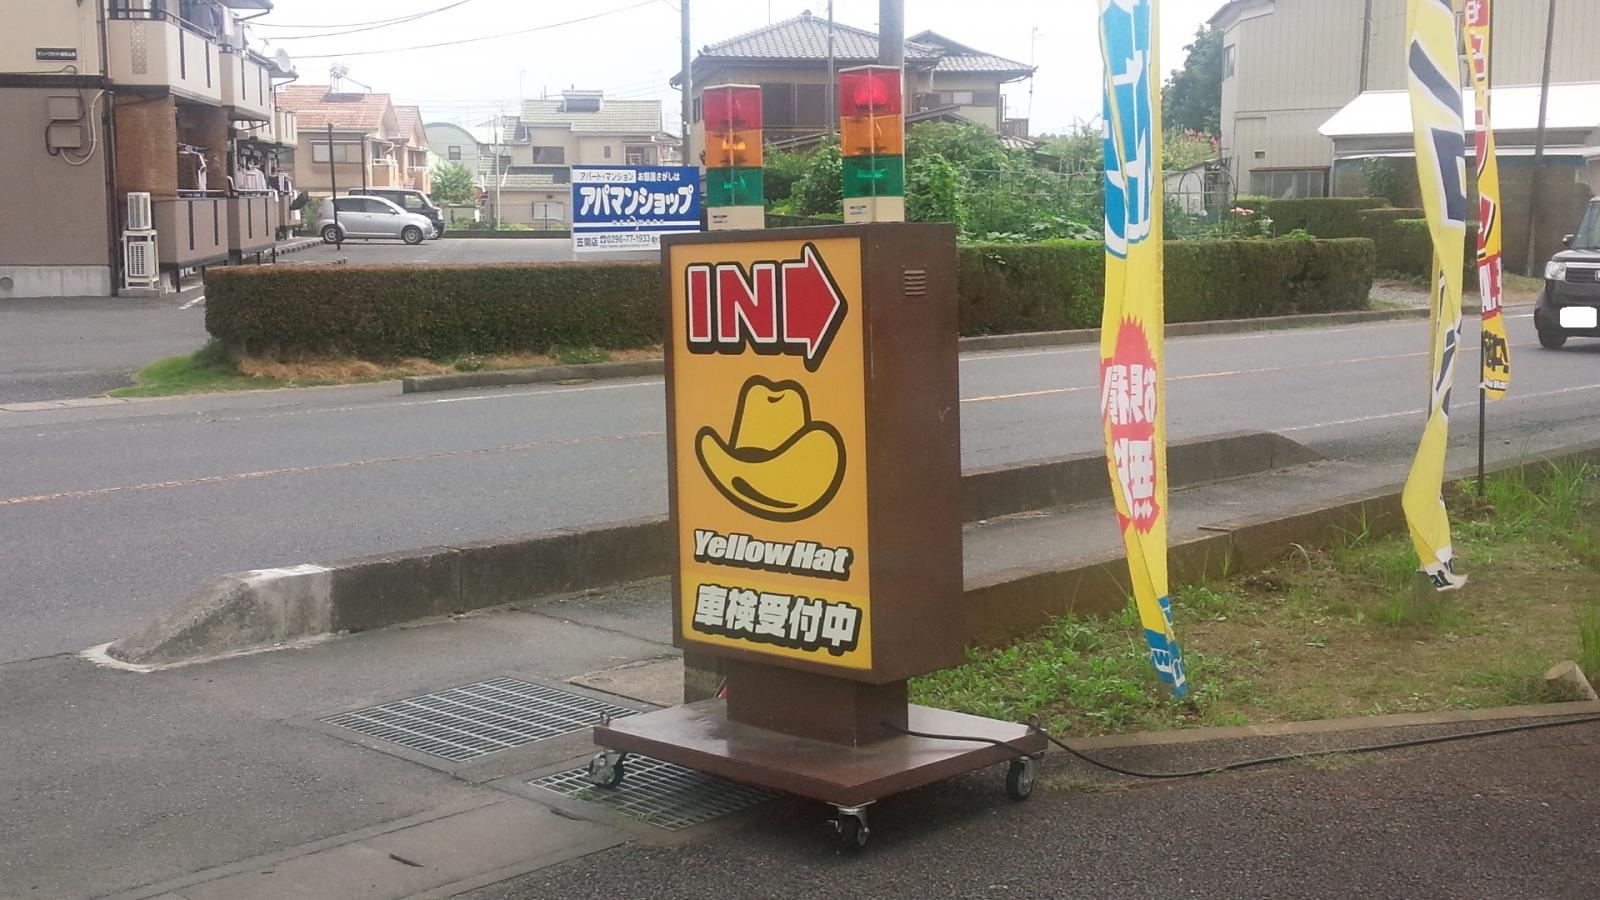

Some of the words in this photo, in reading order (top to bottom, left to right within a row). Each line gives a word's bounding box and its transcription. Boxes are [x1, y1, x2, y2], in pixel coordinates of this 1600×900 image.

[580, 184, 694, 216] アパマンショップ
[687, 261, 779, 350] IN
[693, 584, 860, 652] 車検受付中
